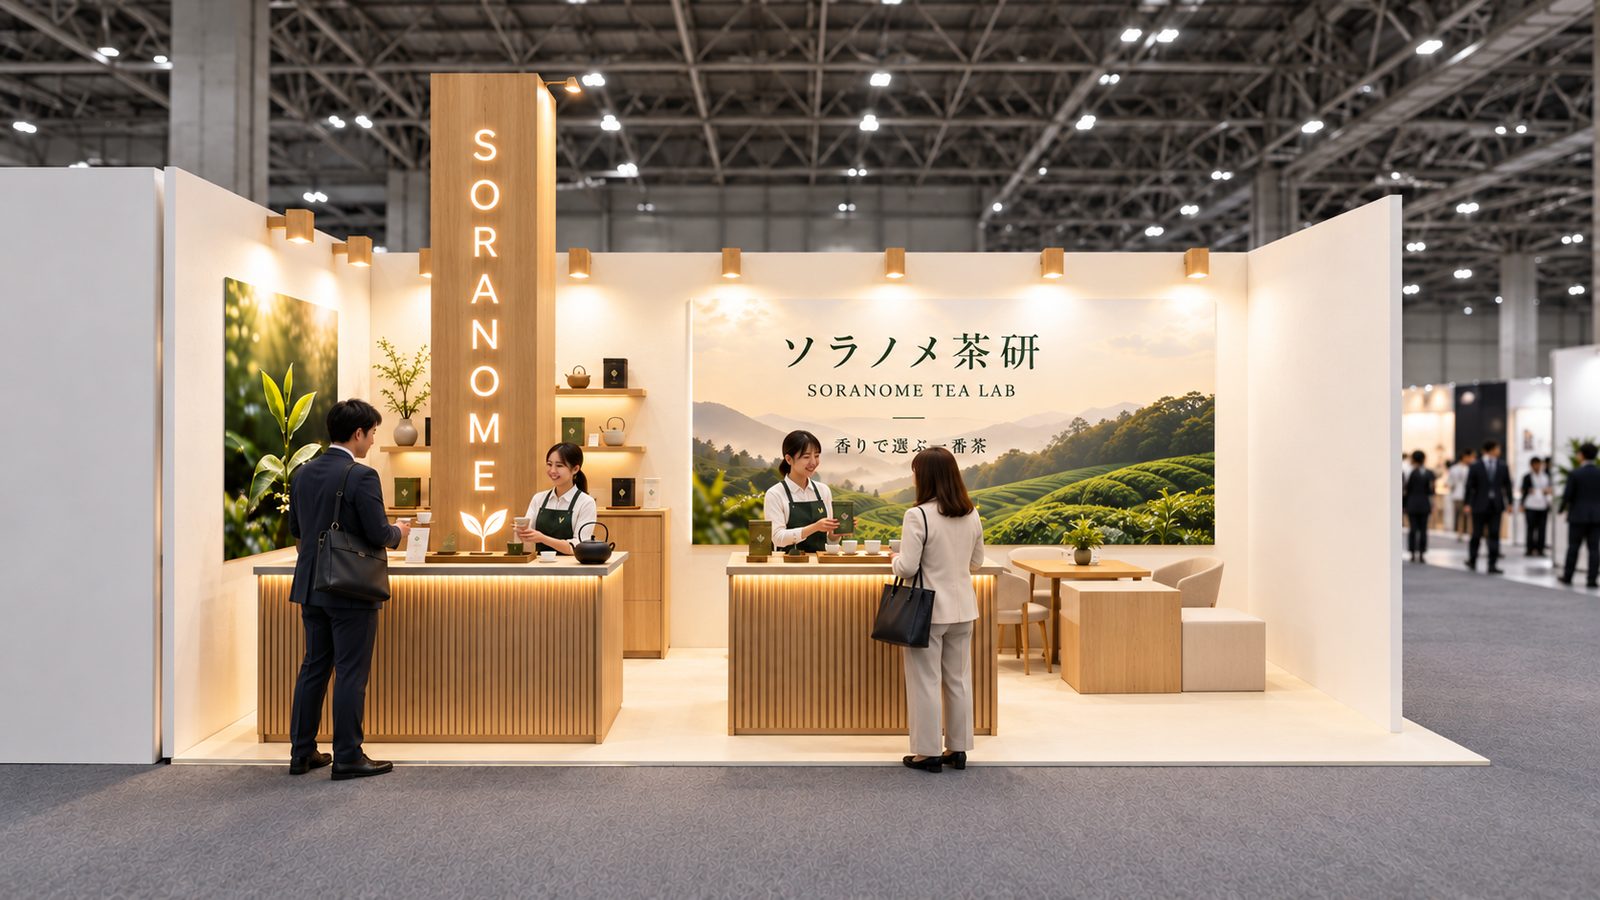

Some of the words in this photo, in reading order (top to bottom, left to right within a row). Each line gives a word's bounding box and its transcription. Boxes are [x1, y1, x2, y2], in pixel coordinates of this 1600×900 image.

[469, 129, 501, 491] SORANOME
[785, 333, 1040, 370] ソラノメ茶研
[807, 384, 923, 398] SORANOME
[932, 384, 970, 398] TEA
[979, 384, 1016, 398] LAB
